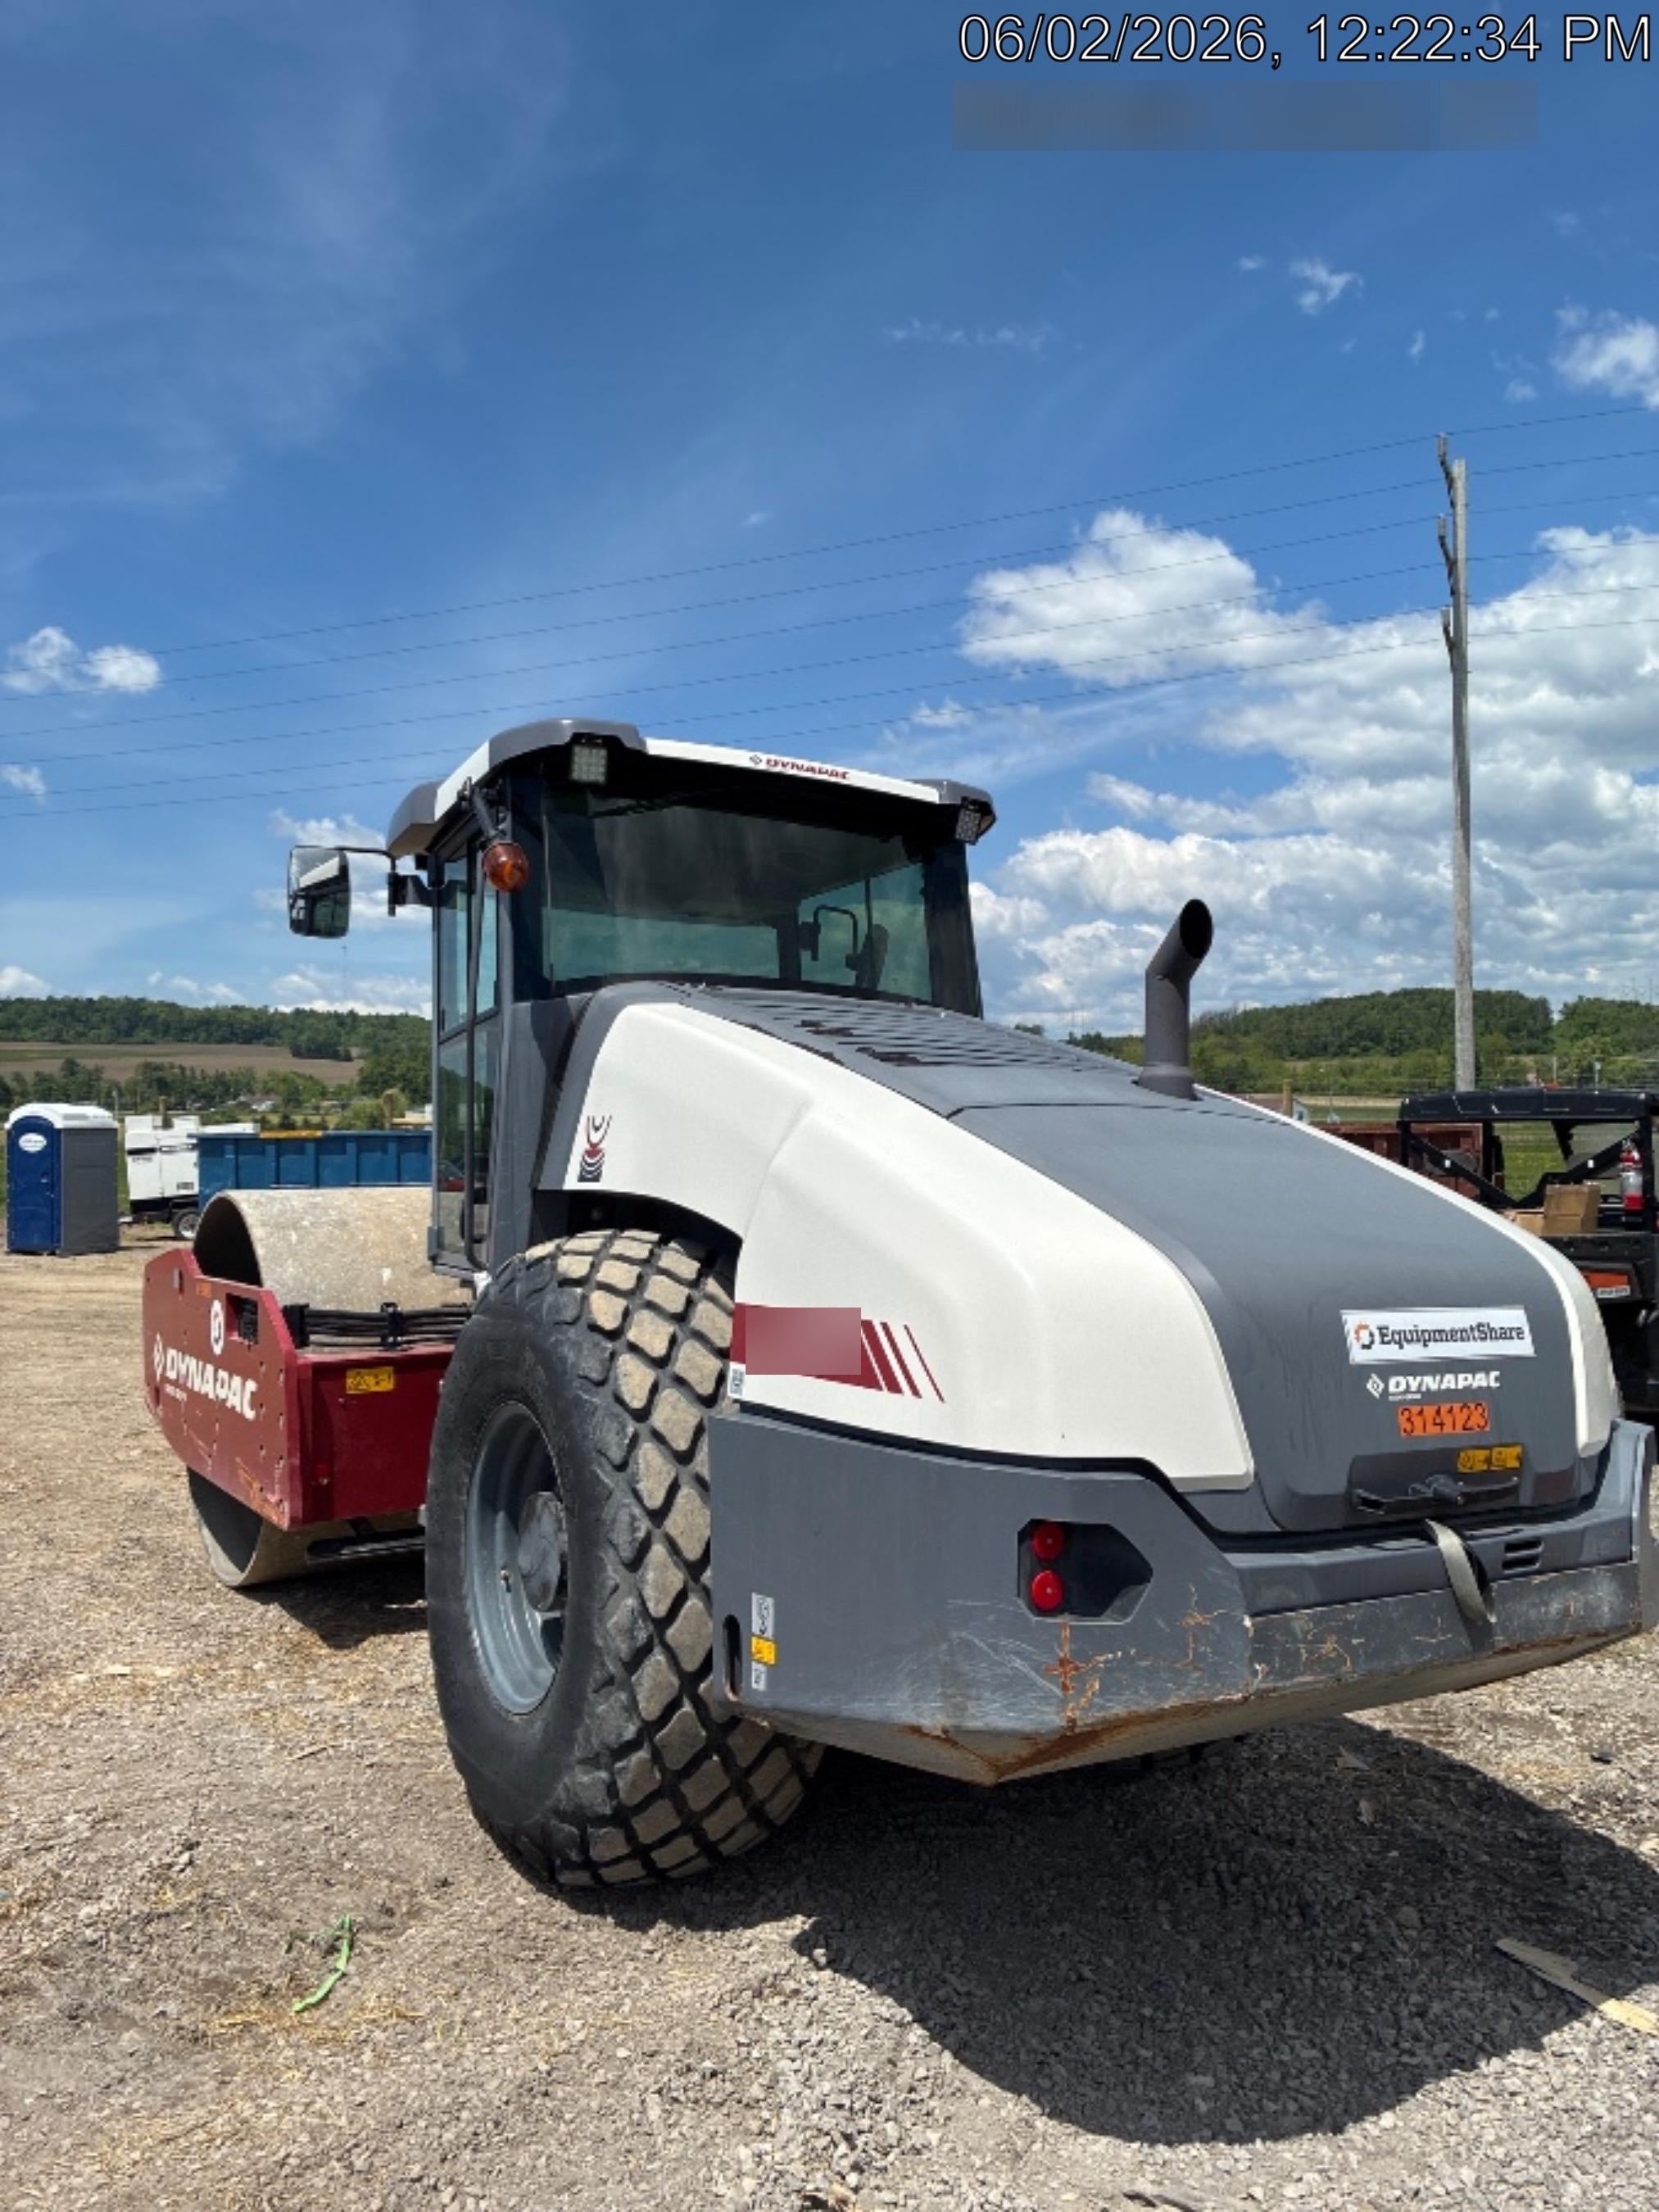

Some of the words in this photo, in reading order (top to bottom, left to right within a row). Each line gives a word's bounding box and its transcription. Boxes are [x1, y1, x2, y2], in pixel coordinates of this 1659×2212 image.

[765, 758, 850, 780] DYNAPAC
[1376, 1321, 1525, 1350] EquipmentShare
[165, 1347, 258, 1421] DYNAPAC
[1388, 1371, 1501, 1394] DYNAPAC
[1400, 1402, 1489, 1435] 314123
